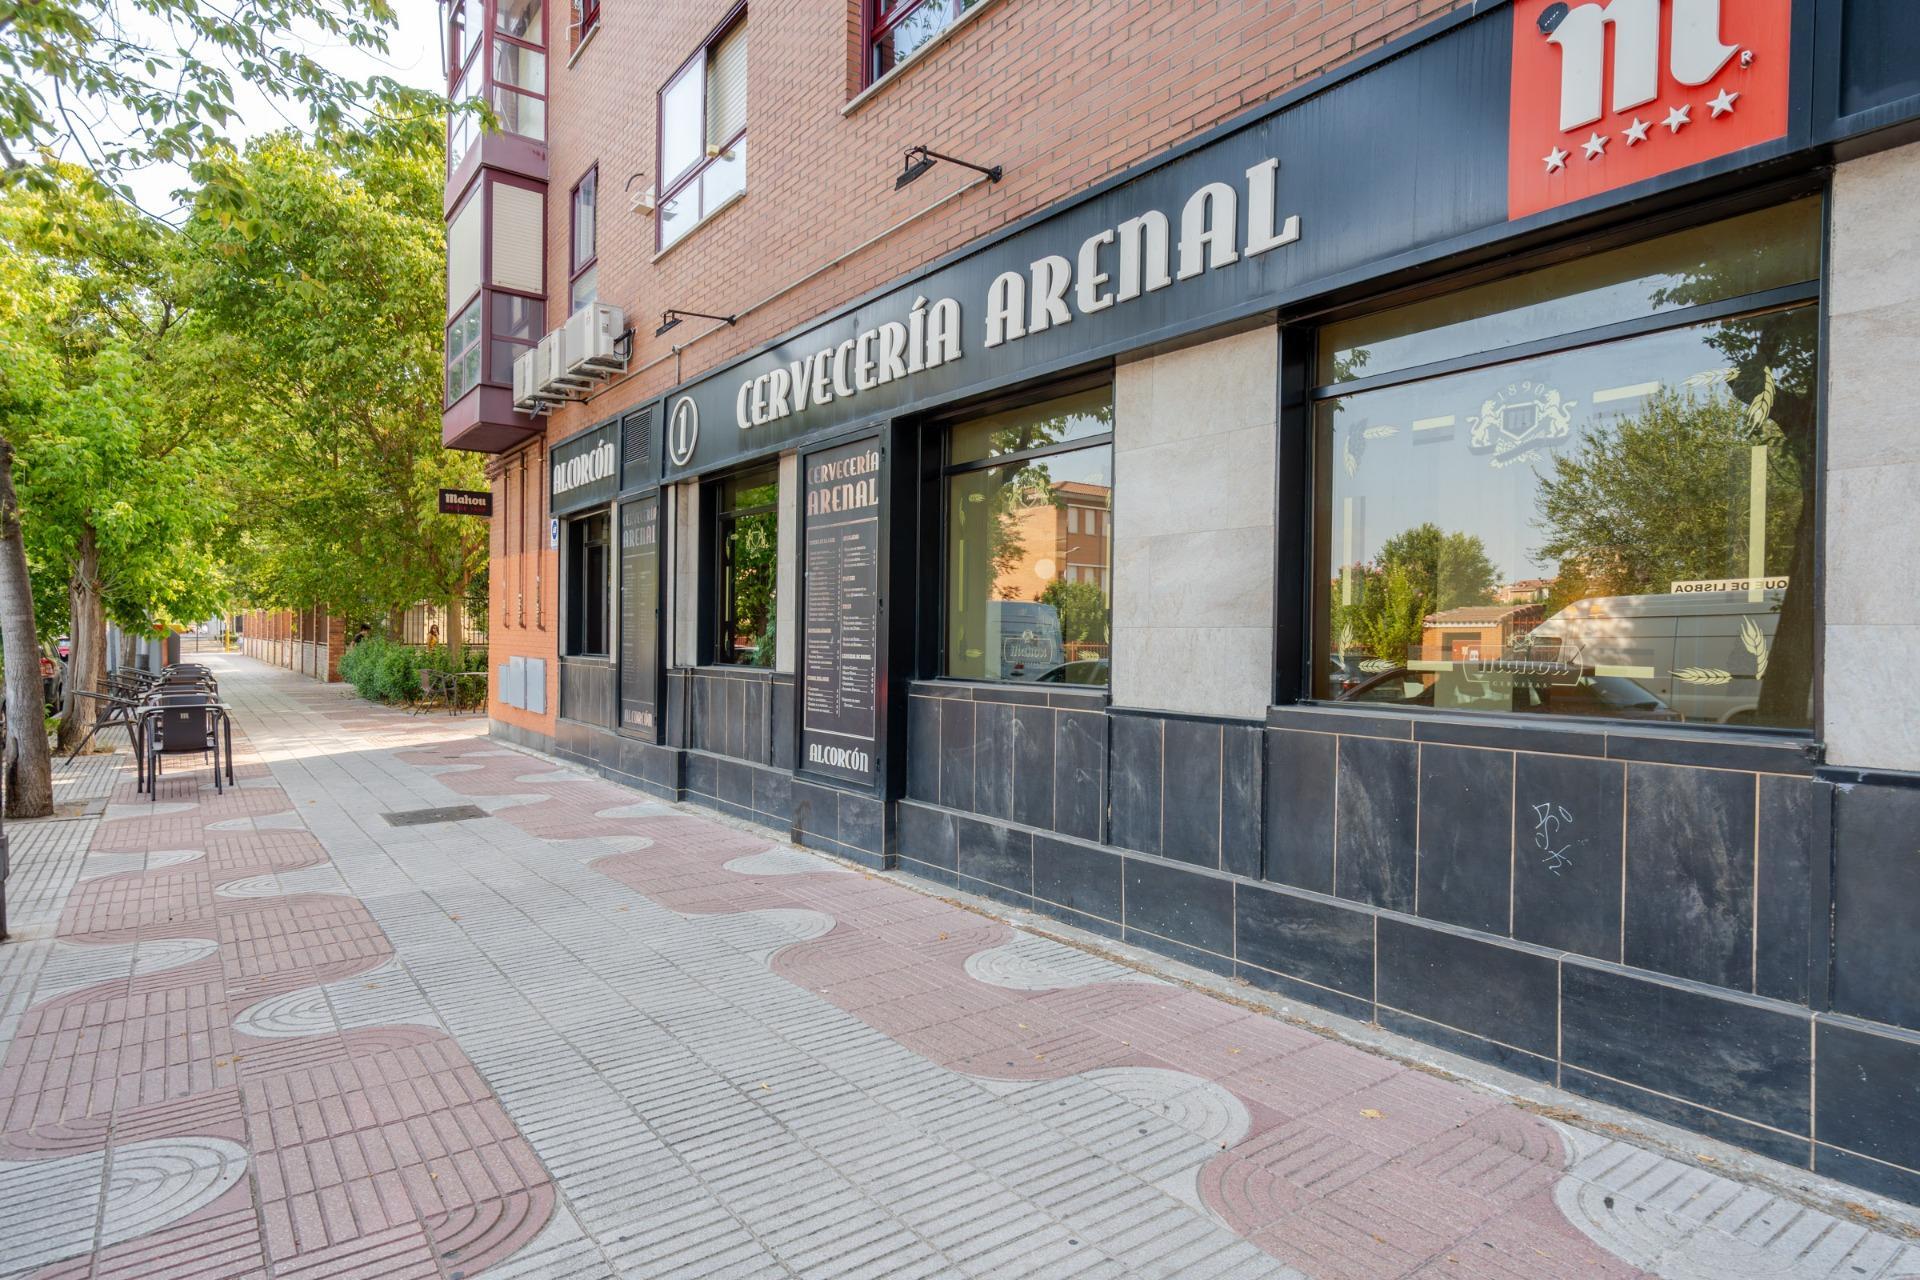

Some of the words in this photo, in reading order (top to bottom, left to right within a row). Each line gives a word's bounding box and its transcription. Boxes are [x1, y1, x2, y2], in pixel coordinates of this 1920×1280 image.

[737, 295, 962, 429] CERVECERÍA
[984, 157, 1301, 348] ARENAL
[553, 439, 616, 495] ALCORCÓN
[807, 448, 879, 485] CERVECERÍA
[807, 478, 879, 517] ARENAL
[809, 743, 869, 773] ALCORCÓN
